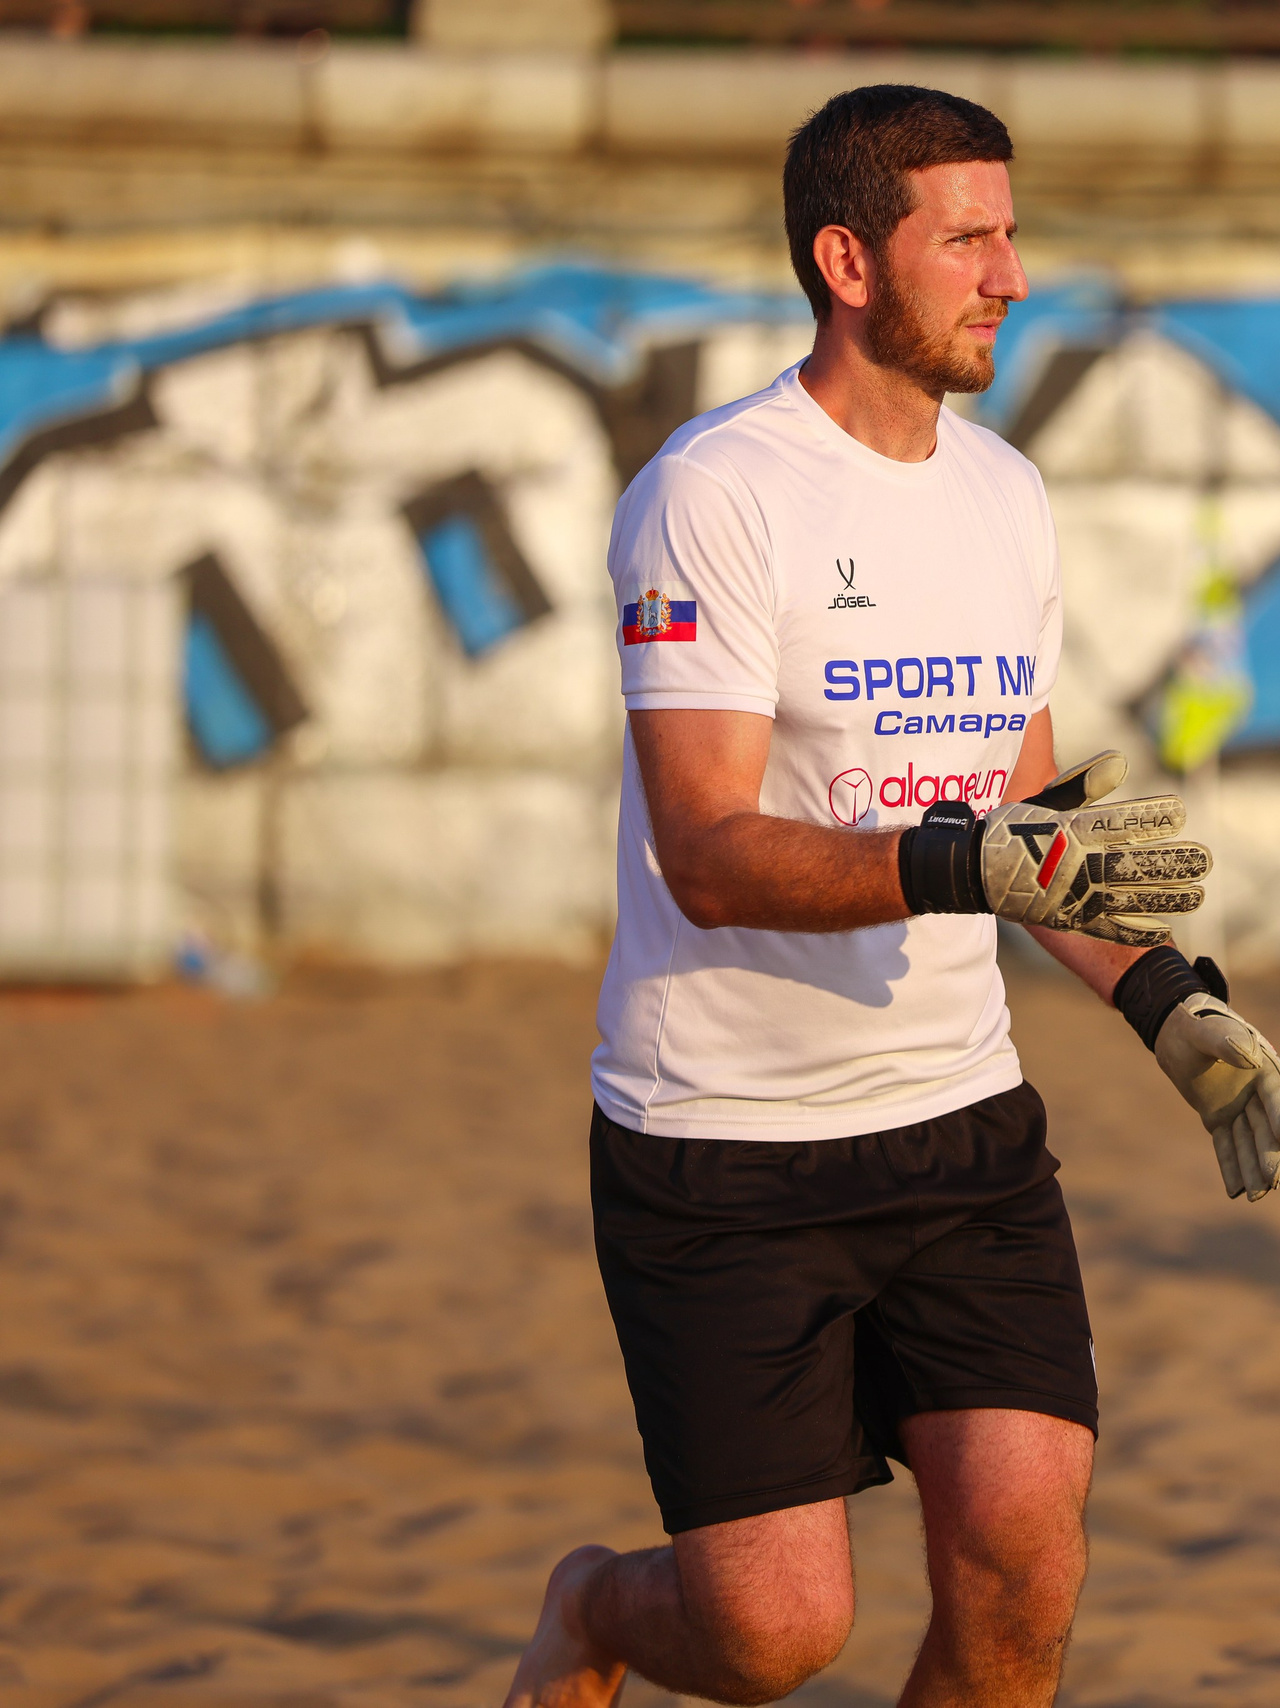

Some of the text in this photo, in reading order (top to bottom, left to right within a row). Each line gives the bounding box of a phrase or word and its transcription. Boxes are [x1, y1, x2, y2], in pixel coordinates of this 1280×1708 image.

[827, 594, 877, 610] JÖGEL
[823, 656, 983, 701] SPORT
[873, 710, 1027, 739] Самара
[927, 815, 968, 826] COMFORT
[1090, 815, 1174, 833] ALPHA
